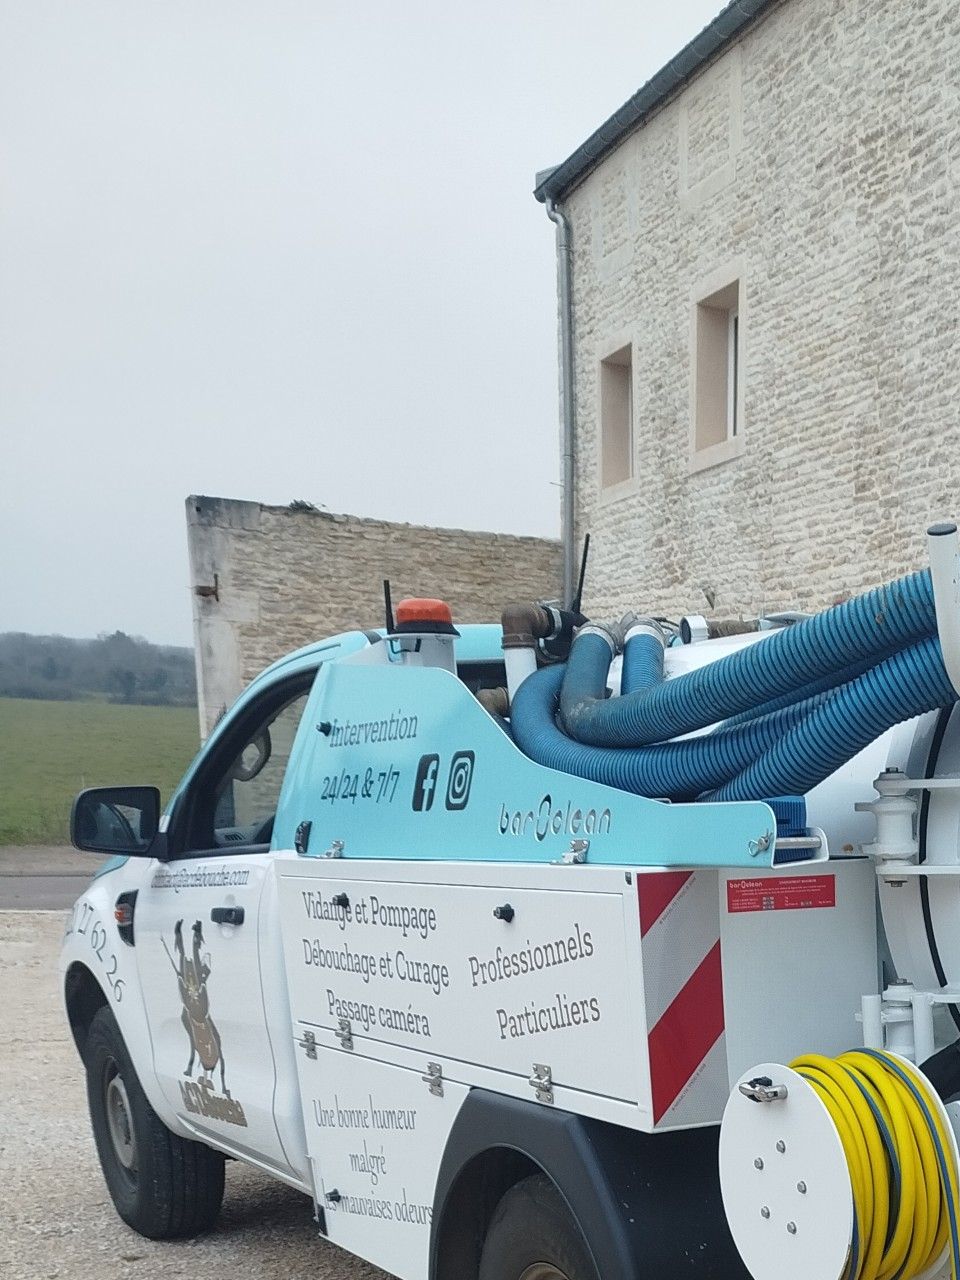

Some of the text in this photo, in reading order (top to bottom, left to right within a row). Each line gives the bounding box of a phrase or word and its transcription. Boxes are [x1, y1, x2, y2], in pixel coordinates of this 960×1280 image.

[320, 763, 400, 805] 24/24 & 7/7
[302, 891, 437, 939] Vidange et Pompage
[91, 920, 106, 963] 62
[106, 954, 126, 1003] 26
[302, 938, 450, 996] Débouchage et Curage
[468, 922, 594, 987] Professionnels
[326, 989, 432, 1038] Passage caméra
[496, 994, 601, 1040] Particuliers
[312, 1094, 418, 1132] Une bonne humeur
[348, 1139, 388, 1186] malgré
[340, 1194, 394, 1221] mauvaises
[393, 1187, 434, 1226] odeurs
